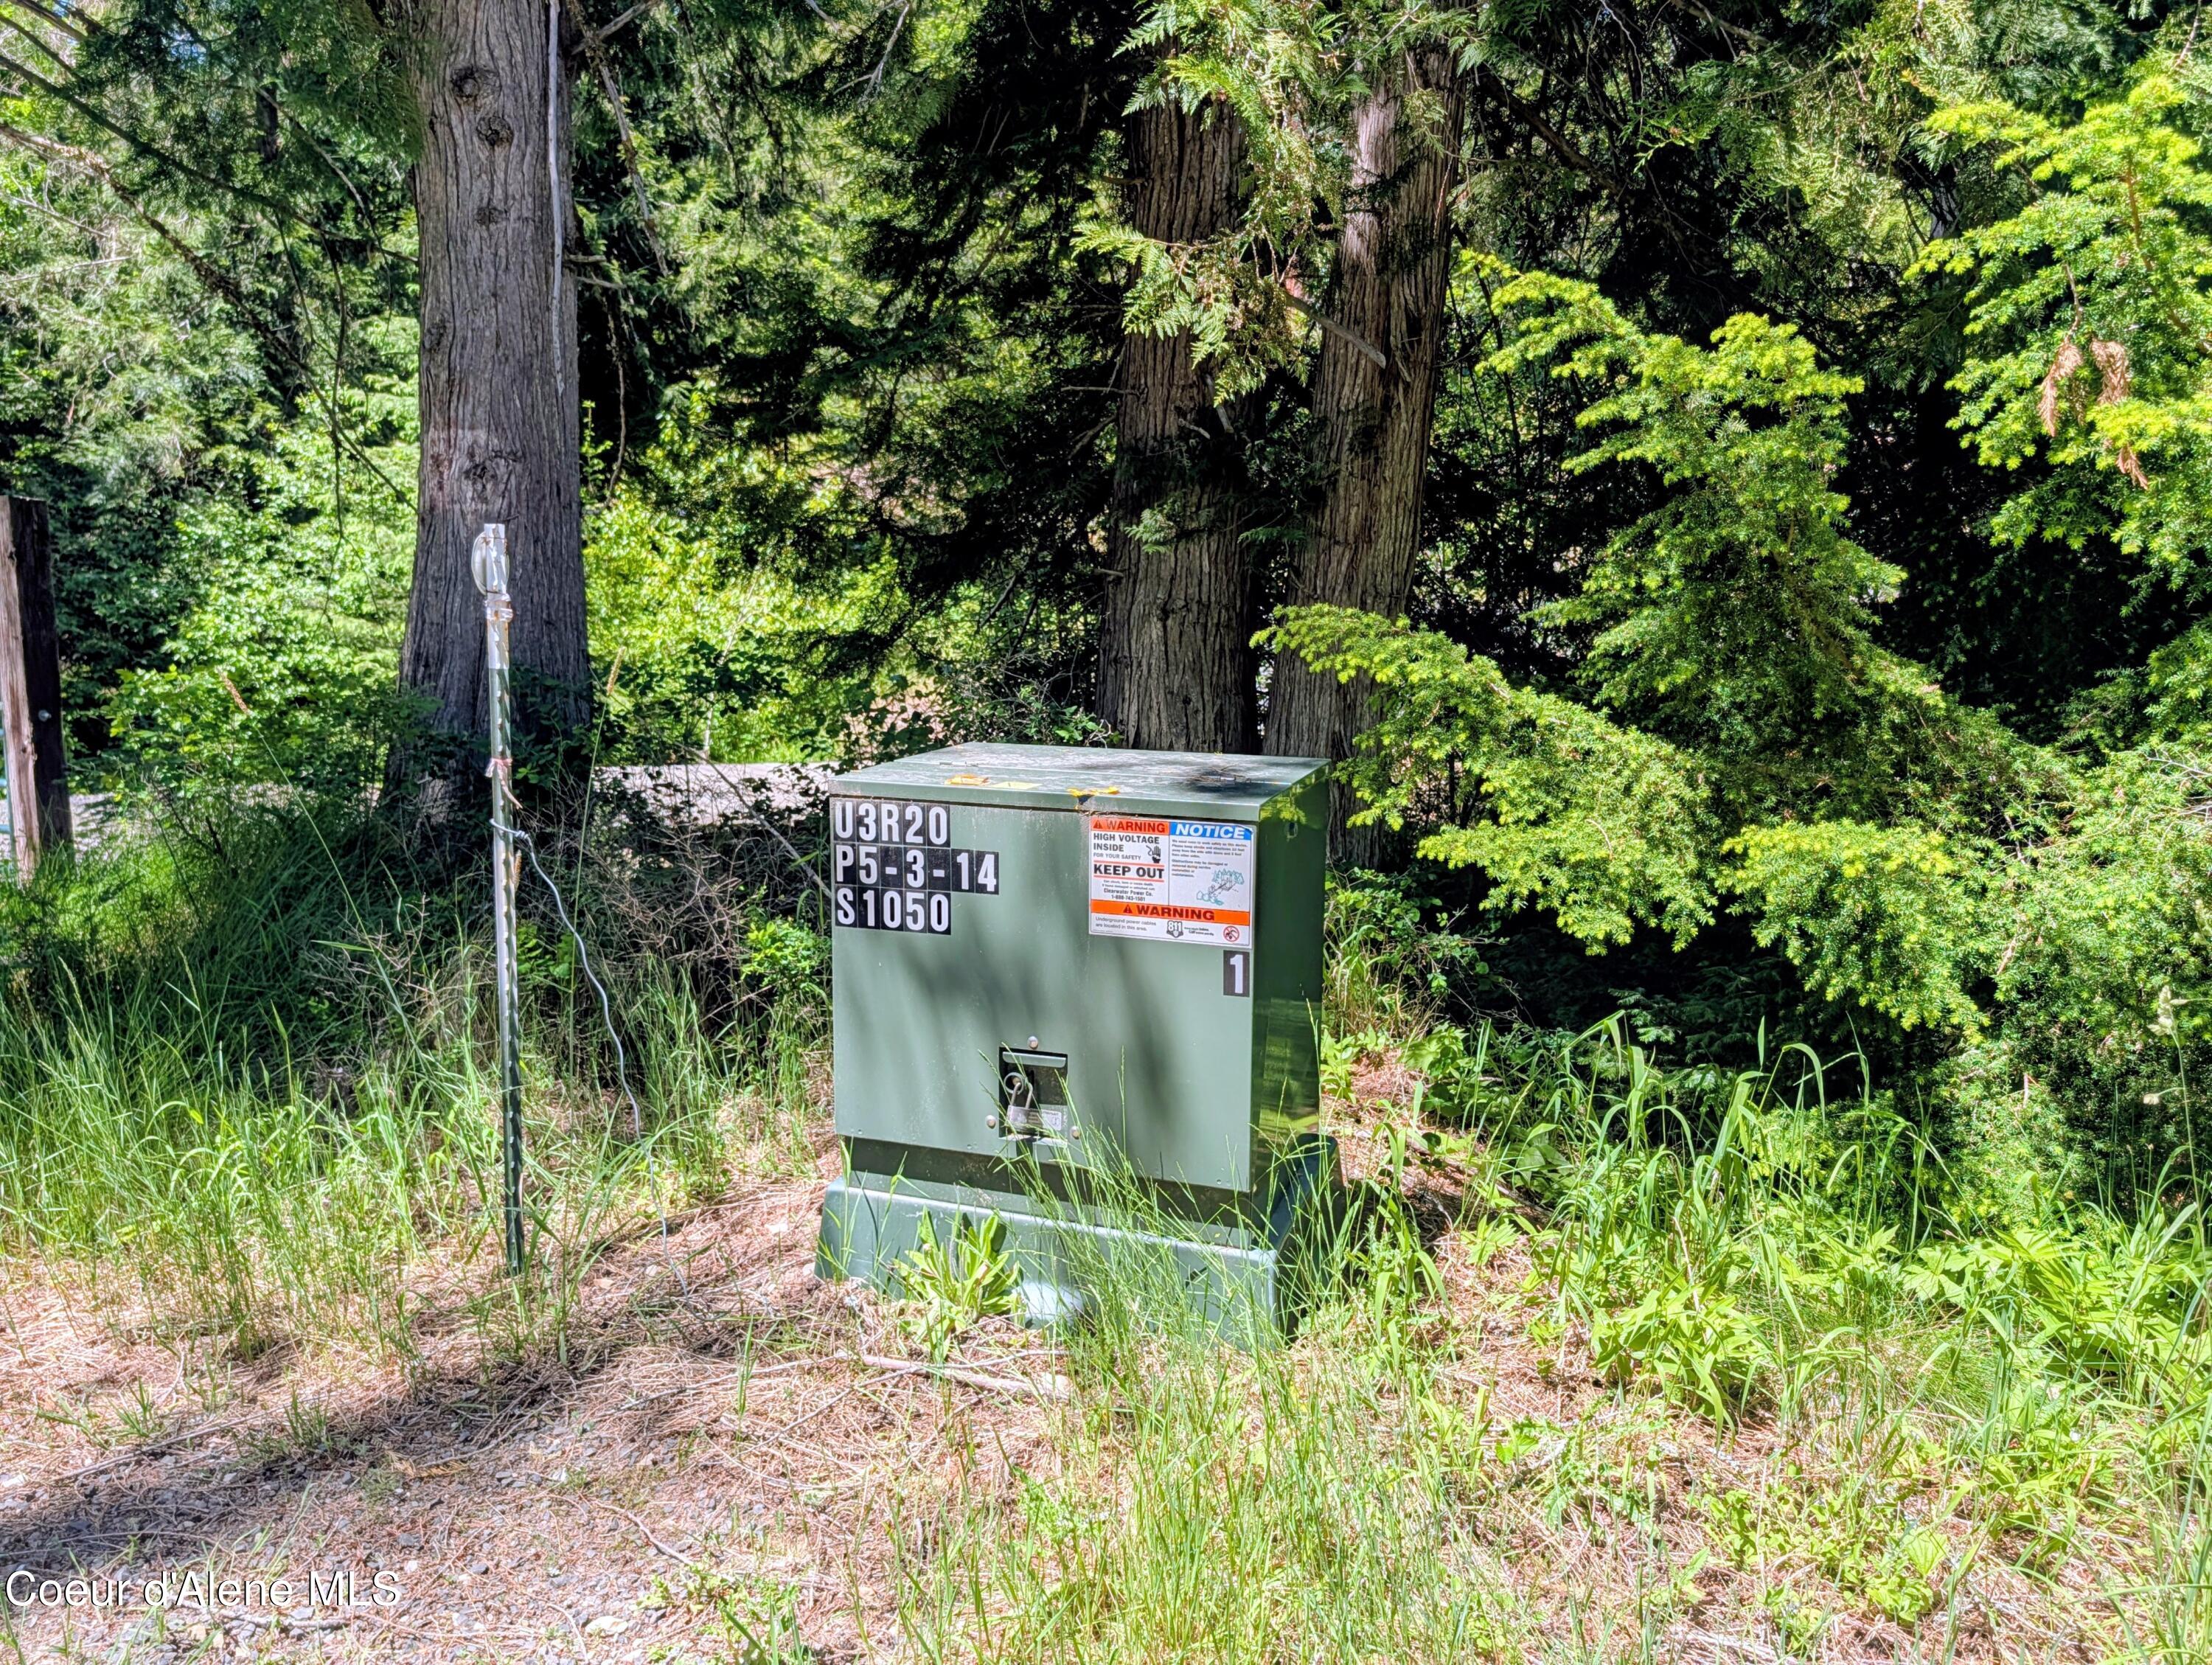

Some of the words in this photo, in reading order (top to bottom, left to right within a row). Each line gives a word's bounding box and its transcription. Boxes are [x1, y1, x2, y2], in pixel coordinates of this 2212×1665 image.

[835, 802, 947, 845] U3R20
[1106, 820, 1165, 833] WARNING
[1093, 833, 1115, 841] HIGH
[1119, 834, 1159, 844] VOLTAGE
[1175, 824, 1245, 839] NOTICE
[1093, 843, 1124, 852] INSIDE
[835, 844, 997, 892] P5-3-14
[1094, 864, 1131, 876] KEEP
[1136, 867, 1164, 878] OUT
[837, 887, 949, 932] S1050
[1136, 905, 1215, 920] WARNING
[1168, 921, 1182, 931] 811
[1230, 954, 1243, 993] 1
